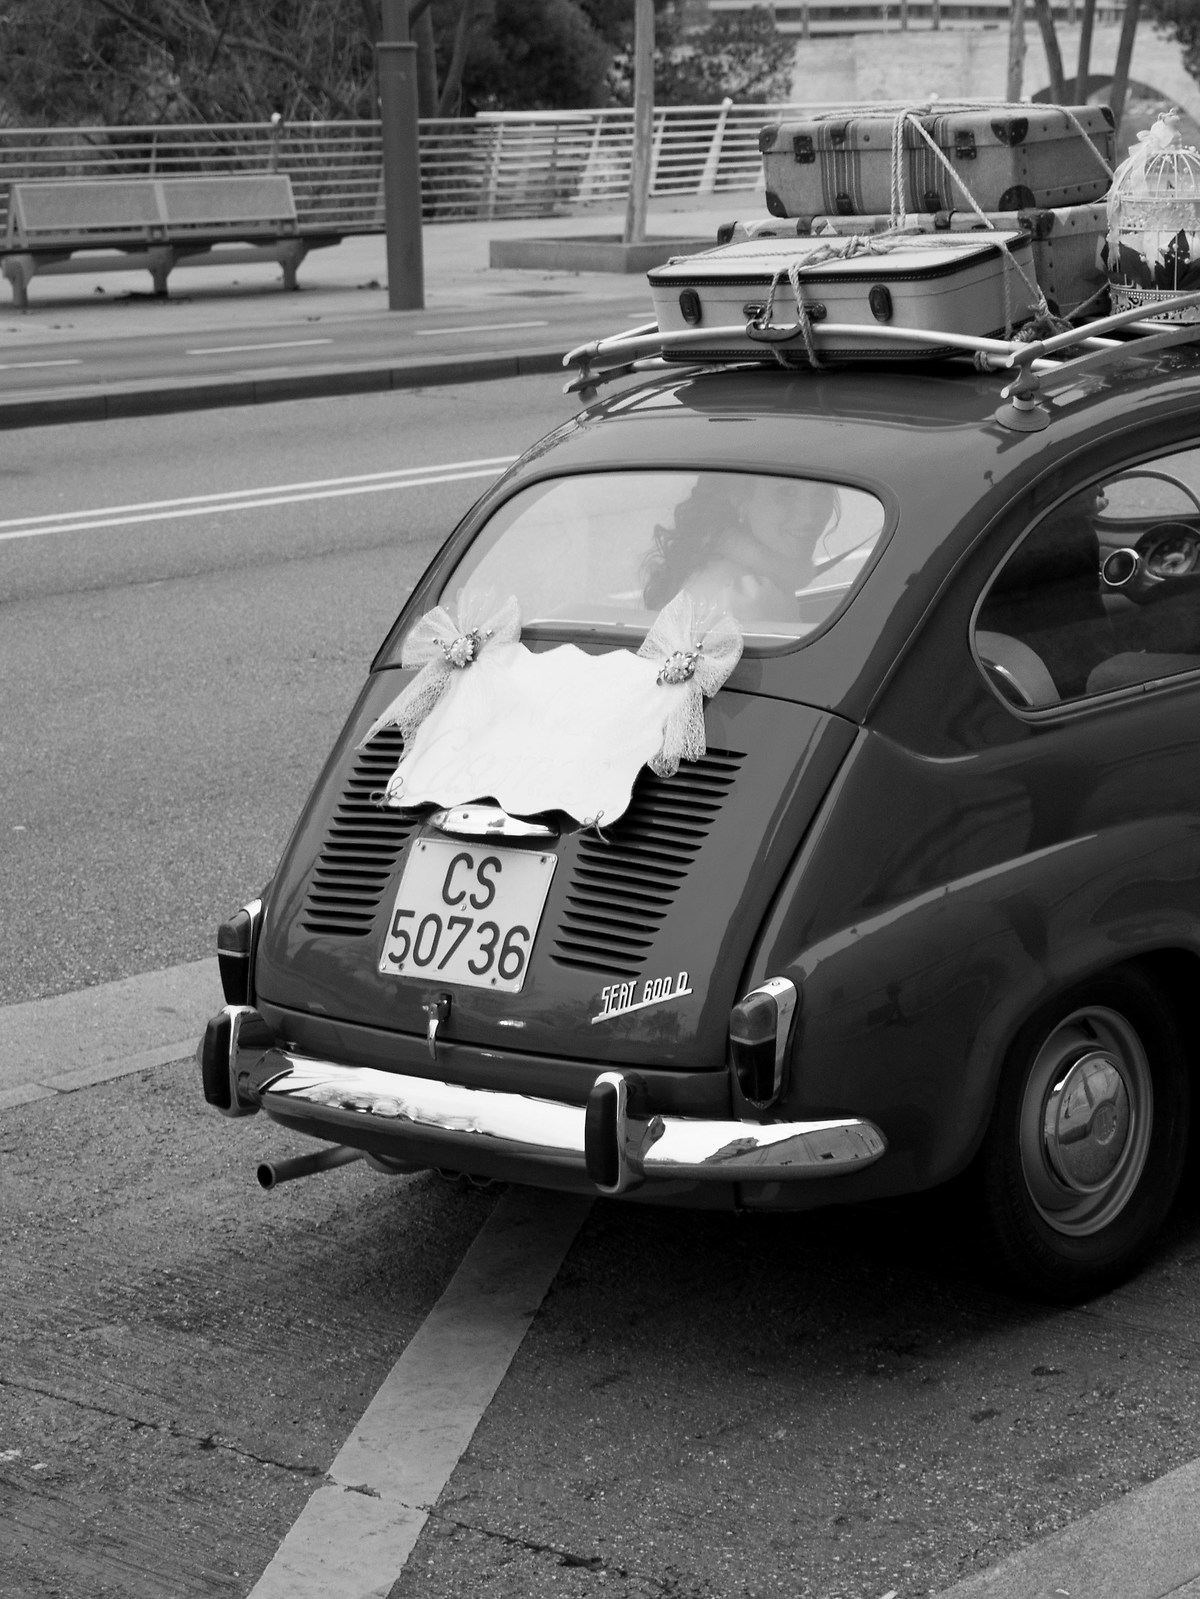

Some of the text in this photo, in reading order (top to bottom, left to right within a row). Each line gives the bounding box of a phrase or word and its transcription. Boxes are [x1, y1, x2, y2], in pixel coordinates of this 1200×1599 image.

[442, 852, 503, 910] CS
[388, 908, 531, 981] 50736
[601, 971, 689, 1015] SEAT 600 D
